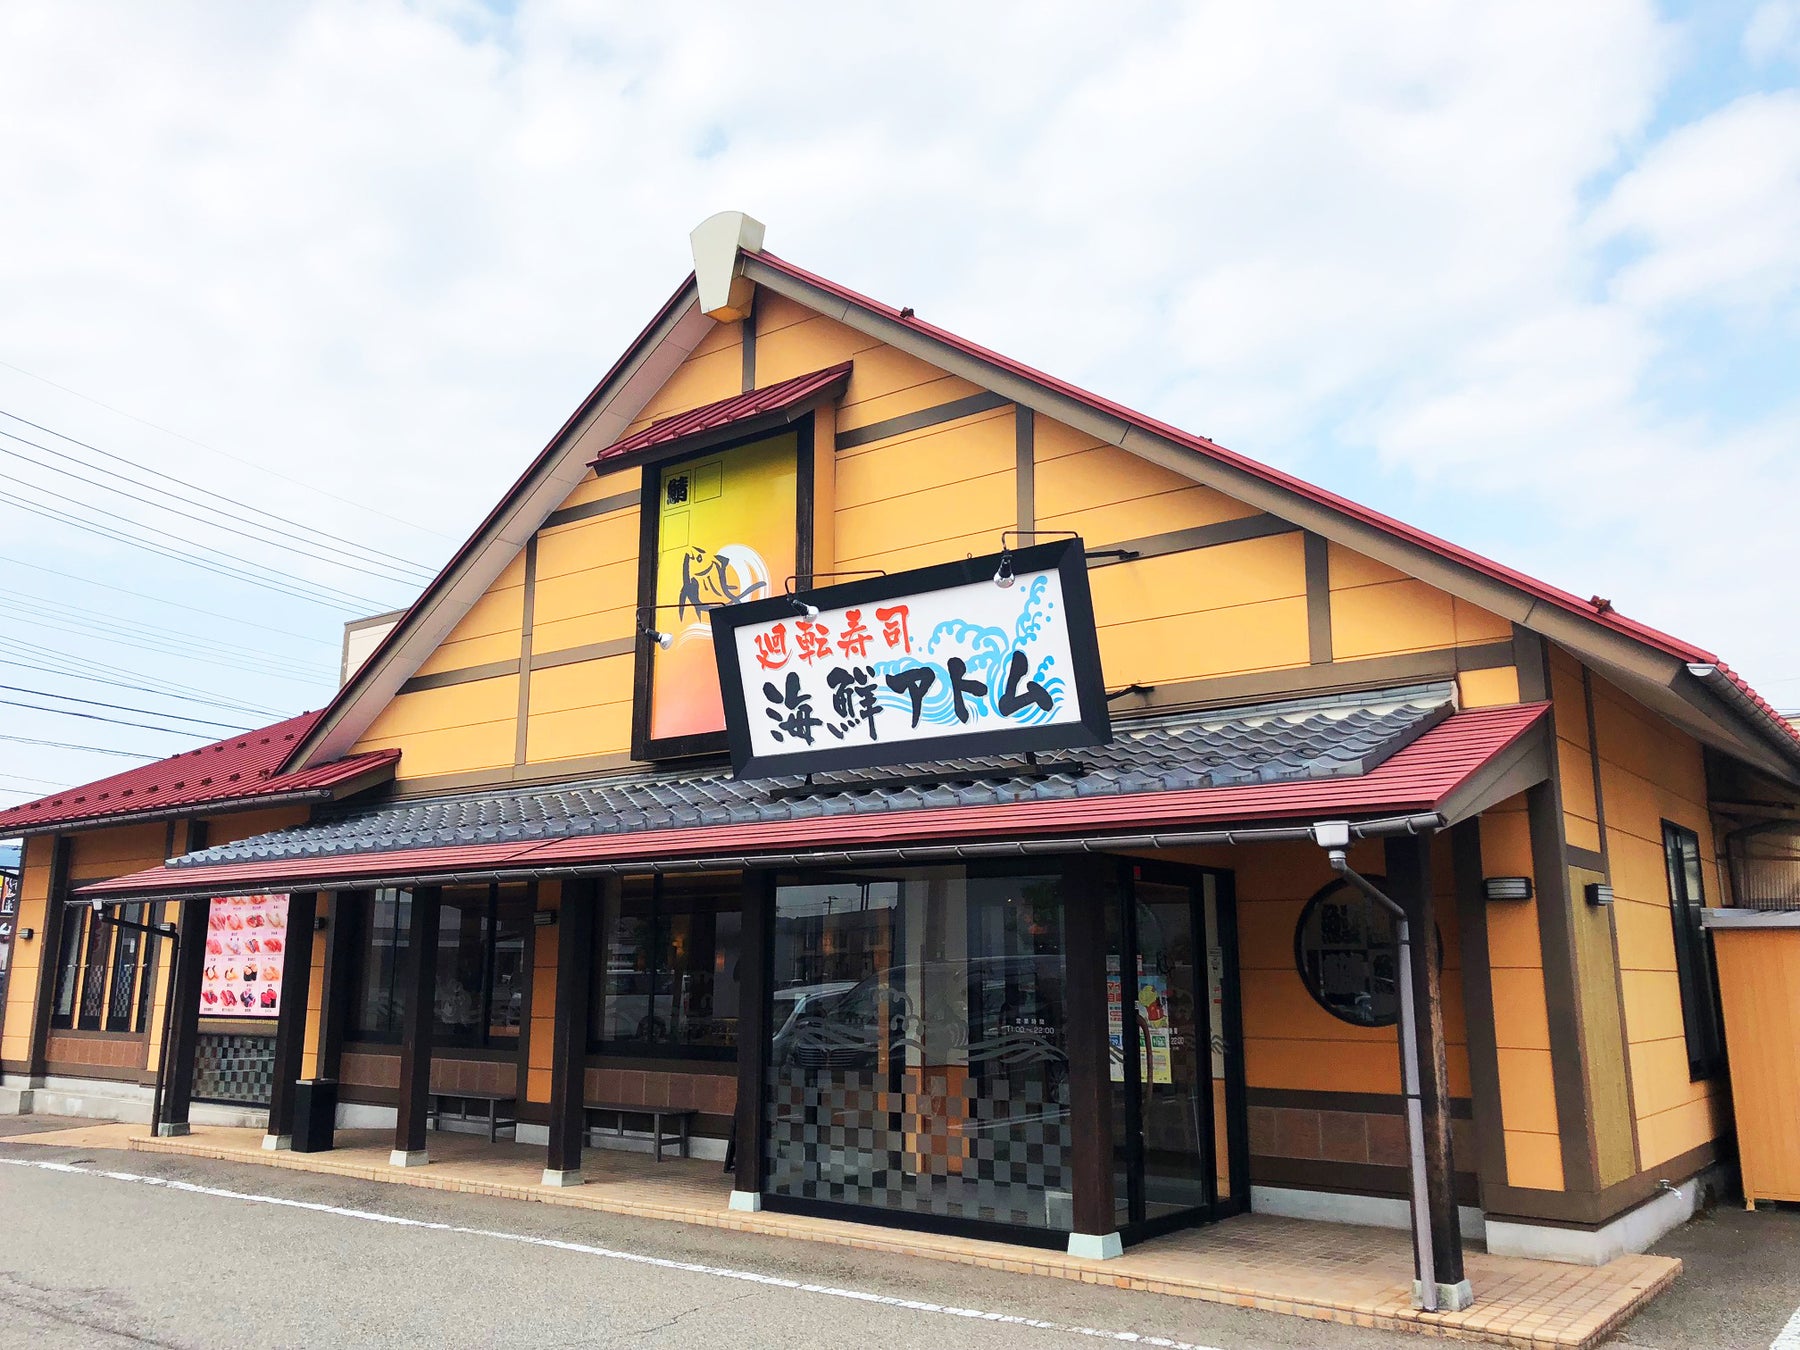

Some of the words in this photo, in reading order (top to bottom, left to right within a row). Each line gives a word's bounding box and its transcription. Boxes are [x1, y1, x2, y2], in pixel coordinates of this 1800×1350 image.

[755, 604, 912, 671] 廻転寿司
[762, 650, 1054, 746] 海鮮アトム
